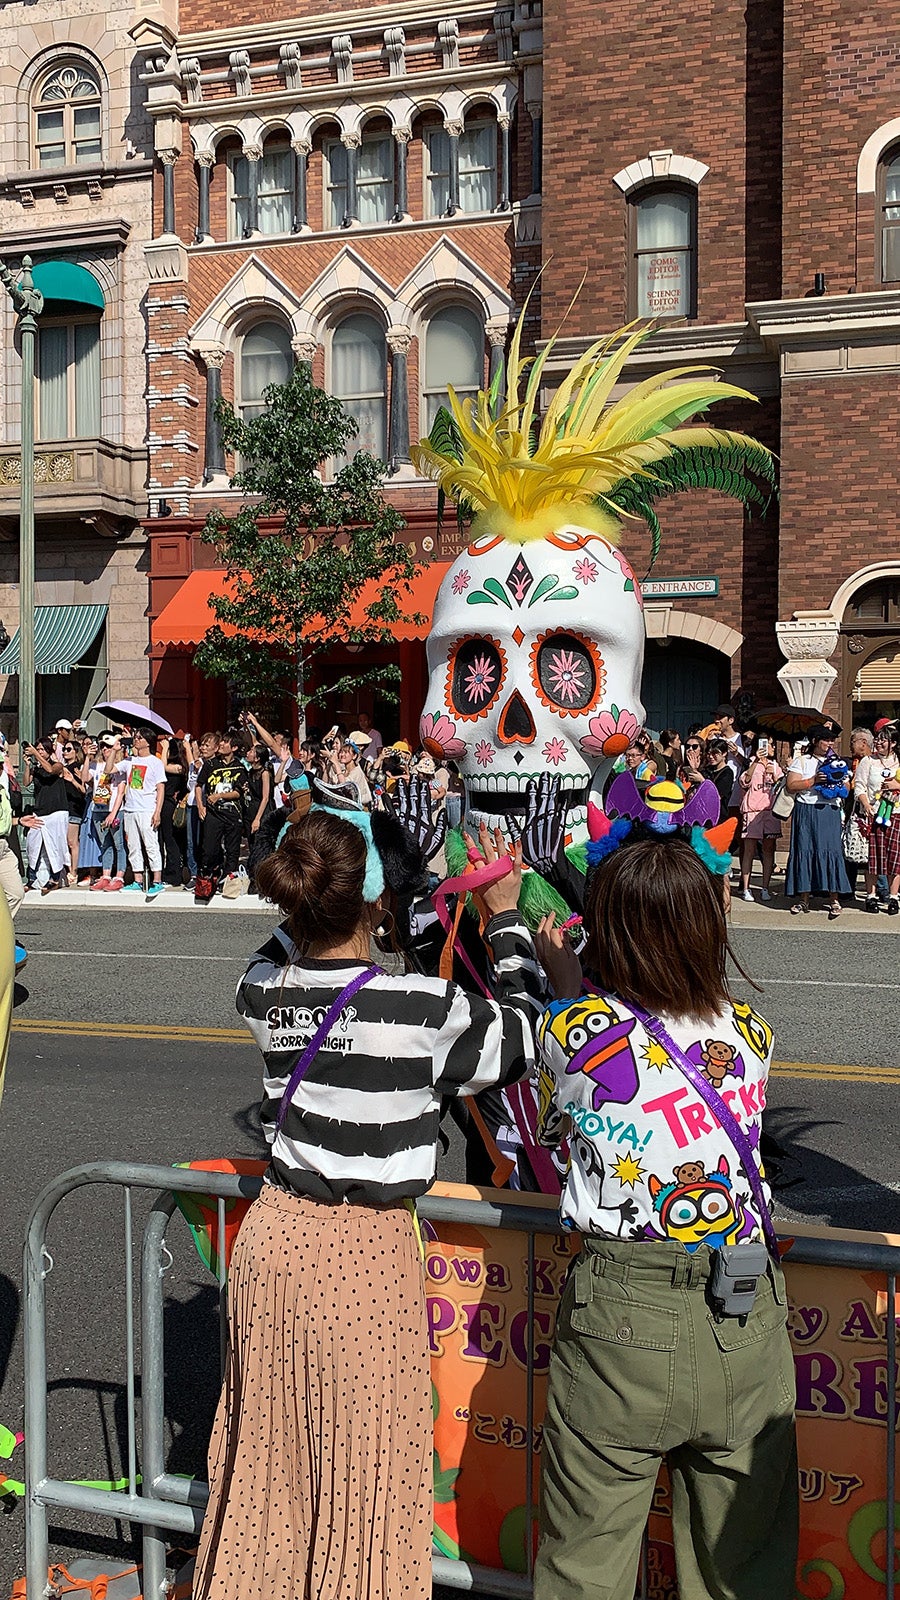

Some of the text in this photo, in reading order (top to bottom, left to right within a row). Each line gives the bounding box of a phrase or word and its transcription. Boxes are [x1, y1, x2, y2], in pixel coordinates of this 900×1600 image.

[650, 257, 679, 266] COMIC
[649, 265, 680, 274] EDITOR
[647, 289, 681, 299] SCIENCE
[649, 297, 679, 306] EDITOR
[441, 545, 468, 556] EXP
[652, 581, 711, 592] ENTRANCE
[267, 1006, 357, 1032] SNOOY
